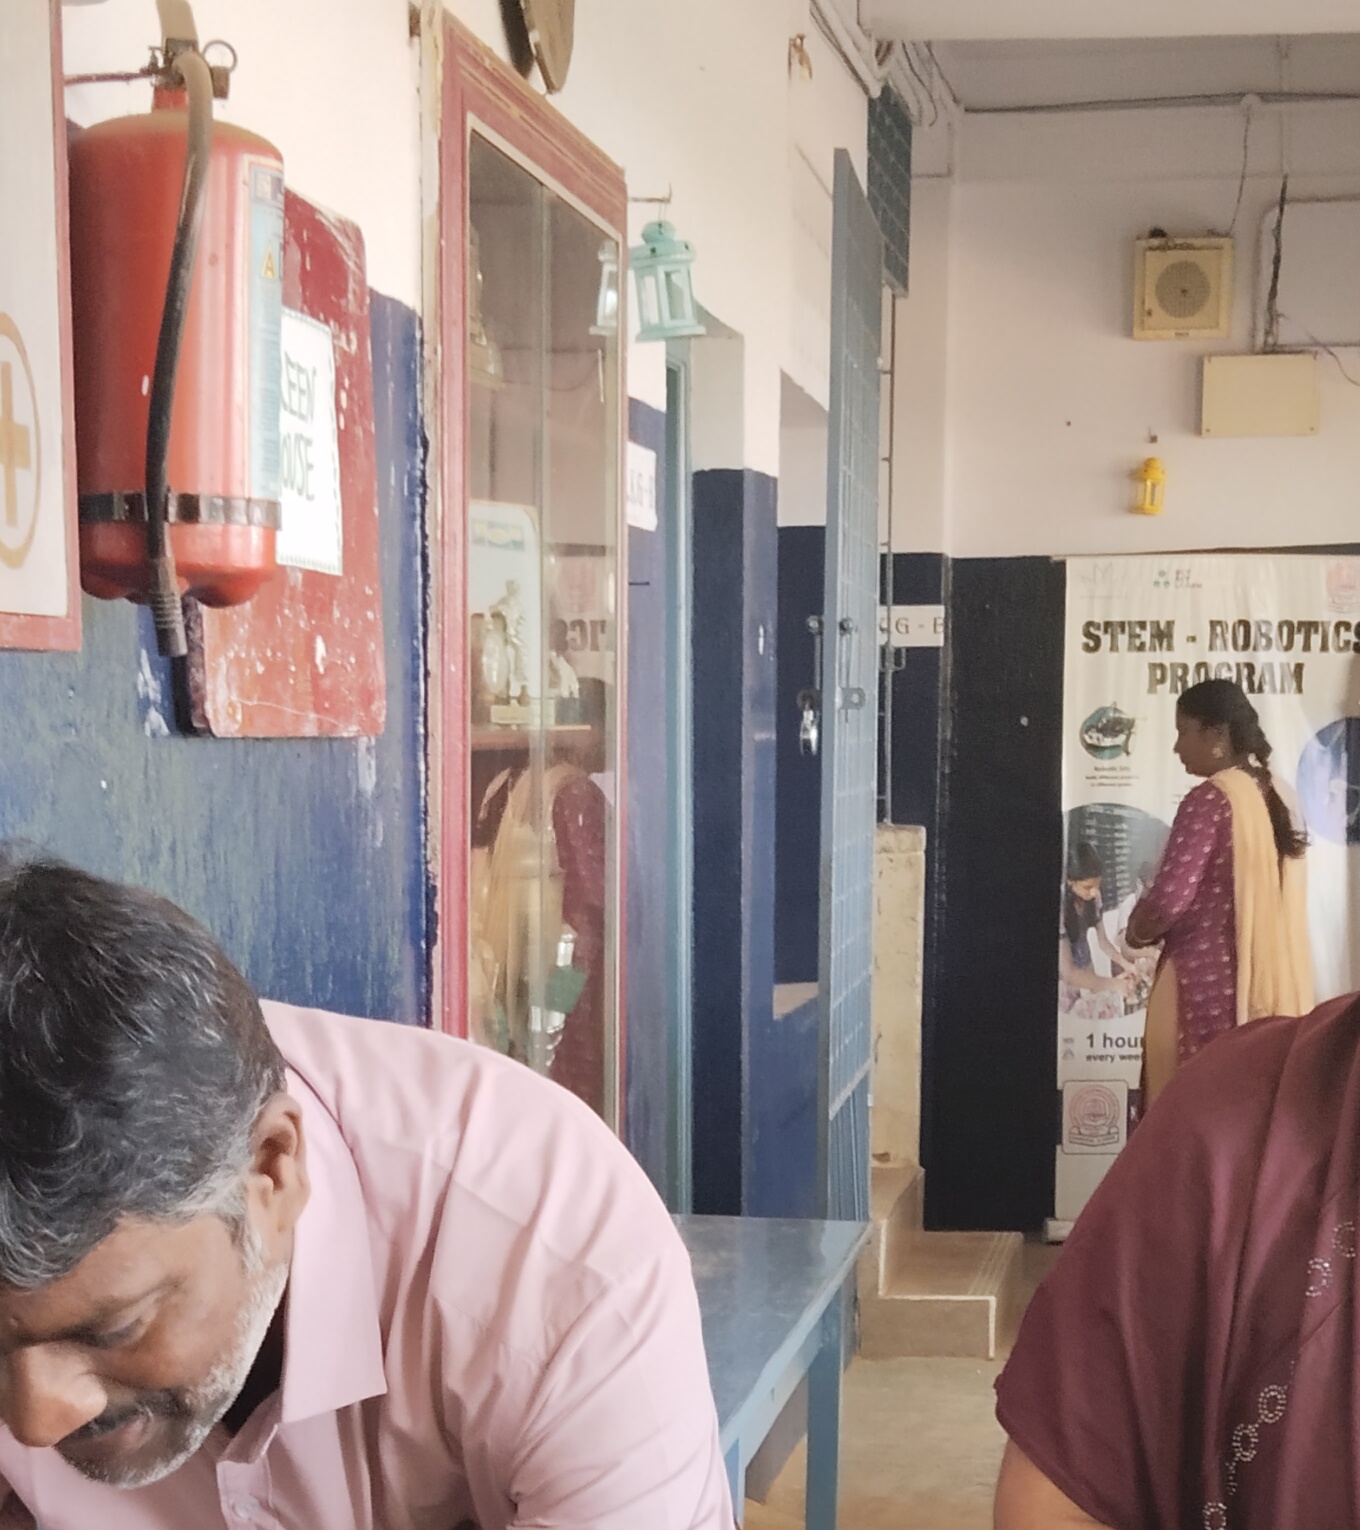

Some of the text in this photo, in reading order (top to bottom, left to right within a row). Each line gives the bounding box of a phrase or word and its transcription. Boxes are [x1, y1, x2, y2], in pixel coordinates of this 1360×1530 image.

[280, 432, 316, 502] OUSE
[1081, 619, 1176, 654] STEM
[1147, 661, 1305, 695] PROGRAM
[1086, 1032, 1095, 1049] 1
[1086, 1054, 1141, 1064] every wee
